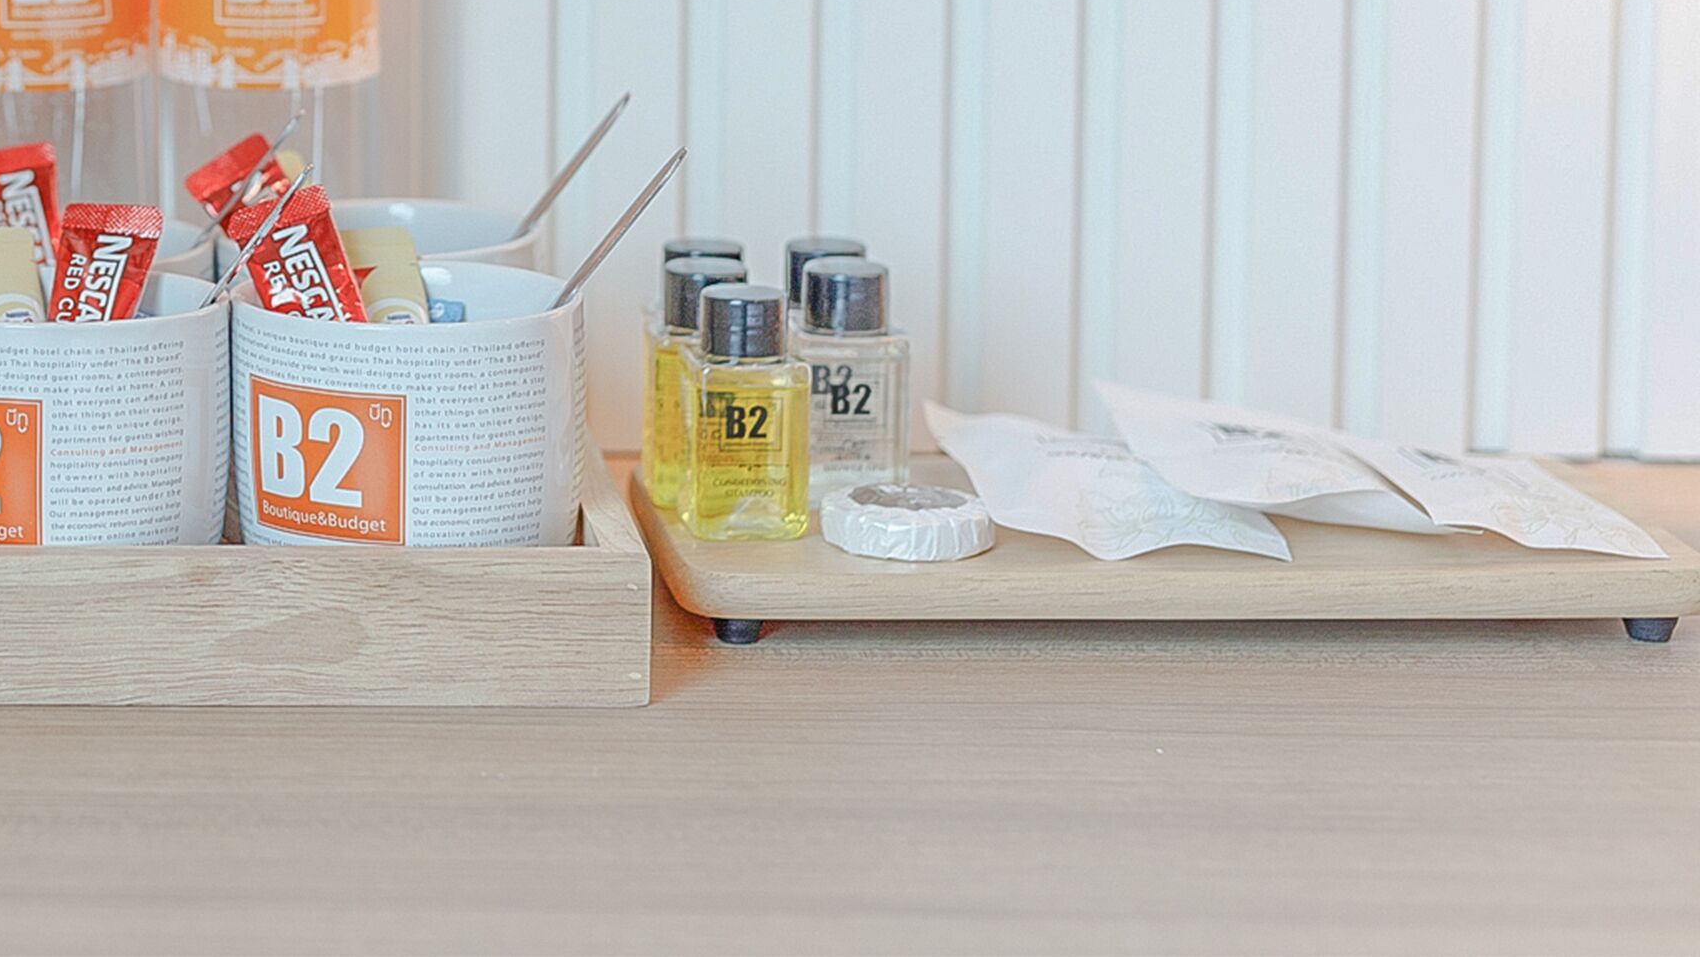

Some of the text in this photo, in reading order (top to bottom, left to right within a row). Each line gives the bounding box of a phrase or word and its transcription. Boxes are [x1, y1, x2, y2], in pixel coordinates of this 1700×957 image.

[64, 253, 88, 290] RED
[33, 348, 60, 356] hotel
[64, 347, 91, 355] chain
[109, 345, 149, 354] Thailand
[289, 335, 328, 348] boutique
[333, 341, 350, 350] and
[354, 342, 392, 353] budget
[396, 346, 423, 354] hotel
[427, 346, 456, 354] chain
[472, 343, 512, 352] Thailand
[271, 346, 307, 357] standards
[310, 351, 326, 360] and
[329, 354, 369, 364] gracious
[396, 358, 450, 367] hospitality
[454, 358, 481, 366] under
[33, 360, 86, 370] hospitality
[90, 360, 118, 368] under
[52, 374, 78, 382] guest
[320, 366, 339, 374] with
[414, 371, 441, 380] guest
[43, 385, 69, 393] make
[94, 385, 113, 393] feel
[406, 383, 432, 391] make
[77, 398, 121, 408] everyone
[440, 396, 484, 405] everyone
[830, 384, 872, 414] B2
[81, 410, 111, 419] things
[444, 408, 474, 418] things
[117, 421, 149, 429] unique
[480, 418, 512, 427] unique
[726, 405, 768, 439] B2
[52, 437, 105, 445] apartments
[125, 433, 152, 442] guests
[415, 434, 469, 442] apartments
[488, 430, 515, 440] guests
[51, 440, 183, 458] Consulting and Management
[258, 394, 364, 508] B2
[415, 443, 470, 453] Consulting
[494, 436, 545, 448] Management
[51, 461, 100, 470] hospitality
[103, 456, 148, 467] consulting
[413, 458, 463, 467] hospitality
[466, 454, 511, 465] consulting
[108, 470, 129, 479] with
[134, 465, 182, 477] hospitality
[471, 468, 493, 476] with
[497, 463, 543, 475] hospitality
[51, 484, 122, 493] consultation and
[413, 482, 465, 491] consultation
[88, 496, 131, 506] operated
[135, 492, 164, 501] under
[452, 493, 494, 503] operated
[498, 489, 526, 498] under
[50, 505, 163, 518] Our management services
[412, 502, 525, 515] Our management services
[262, 499, 386, 534] Boutique&Budget
[51, 534, 102, 542] innovative
[107, 531, 135, 540] online
[469, 528, 498, 537] online
